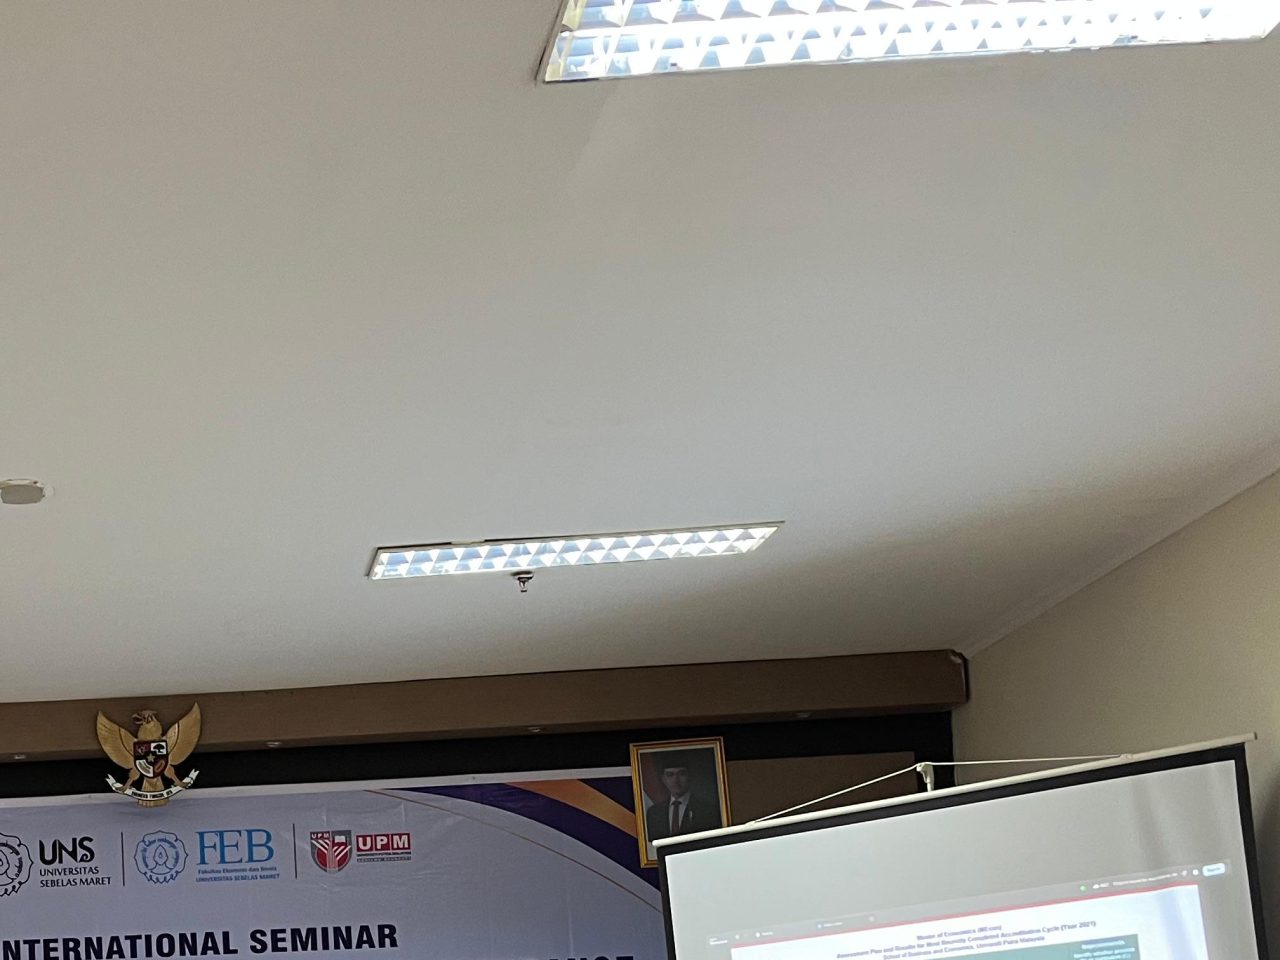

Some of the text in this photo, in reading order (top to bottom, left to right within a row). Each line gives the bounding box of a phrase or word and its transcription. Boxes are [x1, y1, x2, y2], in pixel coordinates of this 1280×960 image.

[39, 836, 95, 866] UNS
[195, 829, 274, 865] FEB
[358, 835, 409, 850] UPM
[39, 866, 99, 876] UNIVERSITAS
[40, 877, 111, 888] SEBELAS MARET
[249, 924, 398, 954] SEMINAR
